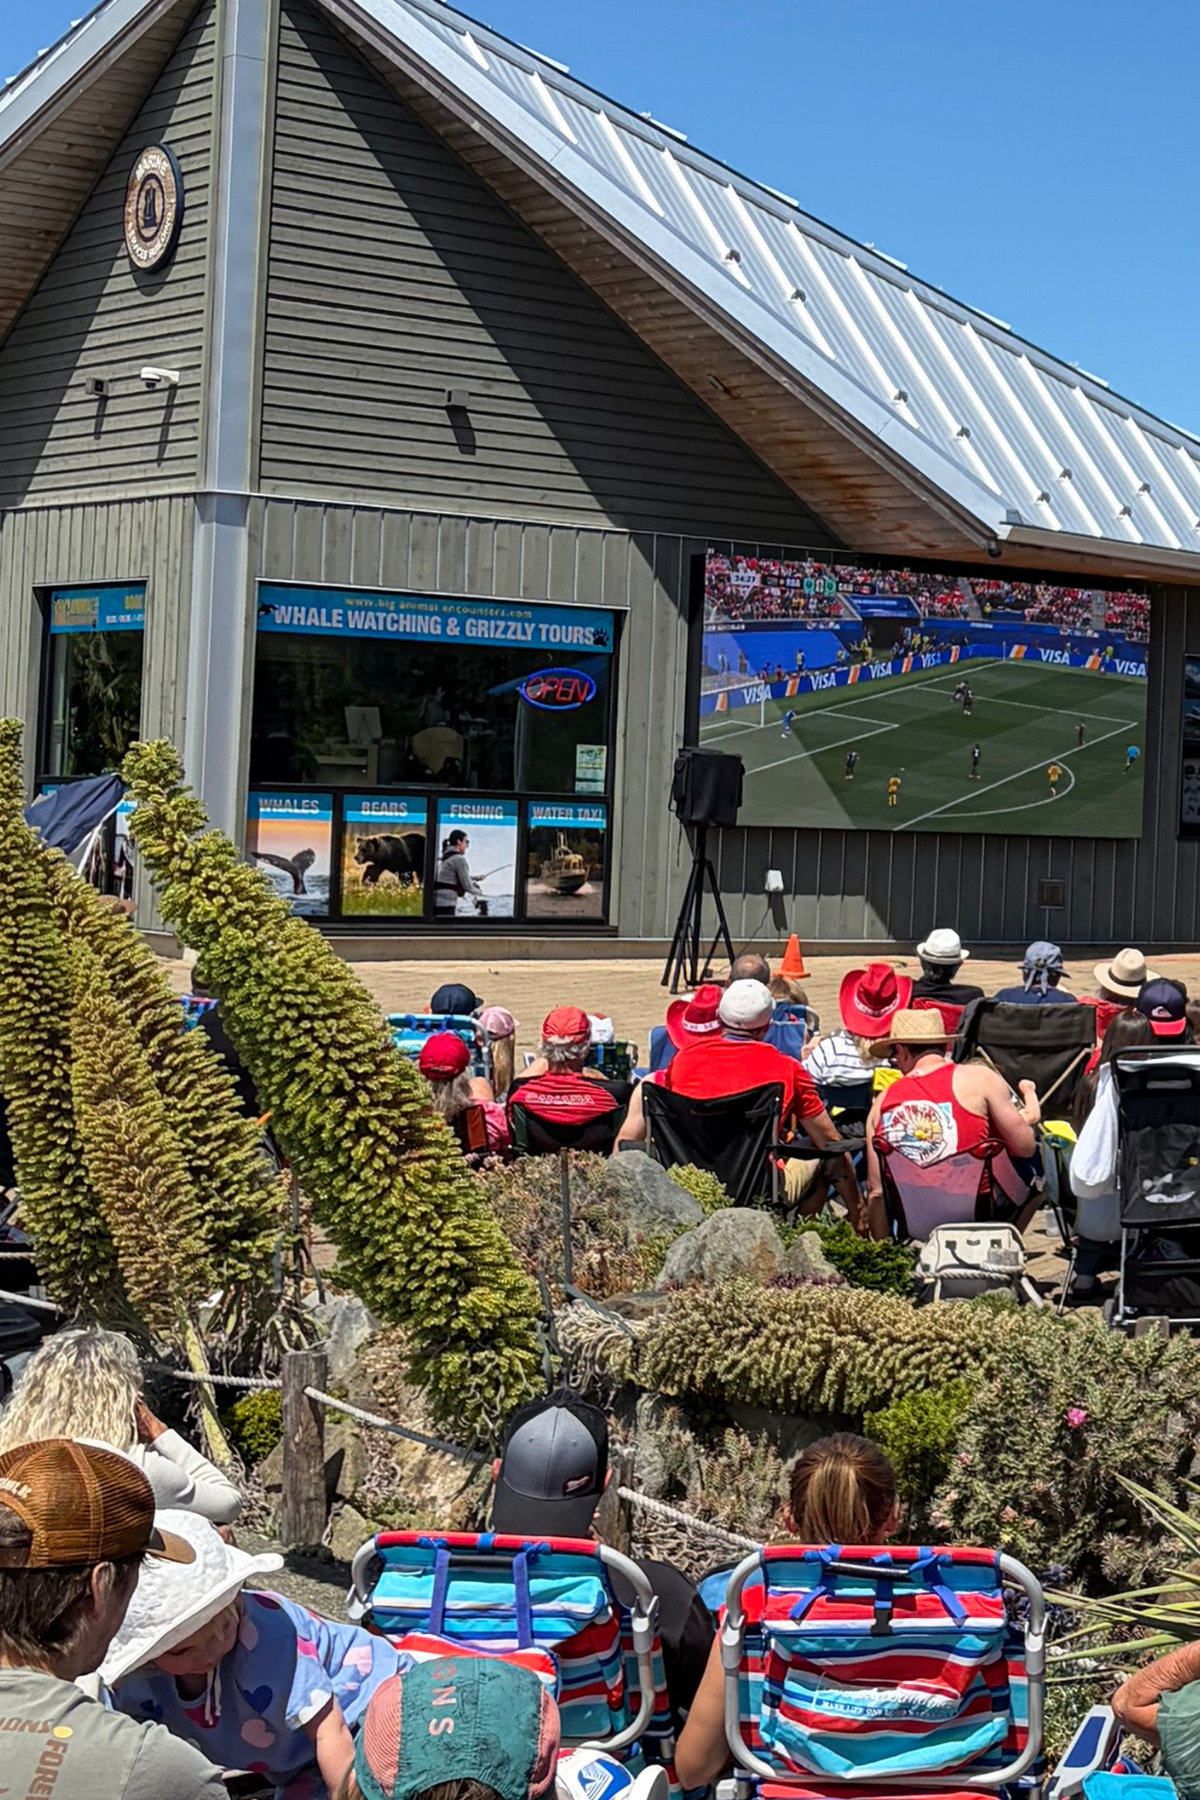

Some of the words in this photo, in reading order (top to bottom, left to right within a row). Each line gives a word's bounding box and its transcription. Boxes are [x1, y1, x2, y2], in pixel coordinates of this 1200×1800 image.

[274, 604, 344, 628] WHALE
[347, 610, 442, 635] WATCHING
[446, 617, 461, 636] &
[465, 617, 536, 642] GRIZZLY
[539, 623, 595, 646] TOURS
[921, 652, 942, 668] VISA
[1040, 648, 1071, 666] VISA
[869, 662, 893, 679] VISA
[1114, 659, 1147, 677] VISA
[525, 676, 590, 703] OPEN
[810, 672, 837, 691] VISA
[742, 684, 772, 704] VISA
[259, 798, 320, 814] WHALES
[361, 801, 408, 817] BEARS
[450, 804, 504, 820] FISHING
[532, 806, 574, 821] WATER
[577, 808, 603, 822] TAXI
[24, 1739, 69, 1800] FORE
